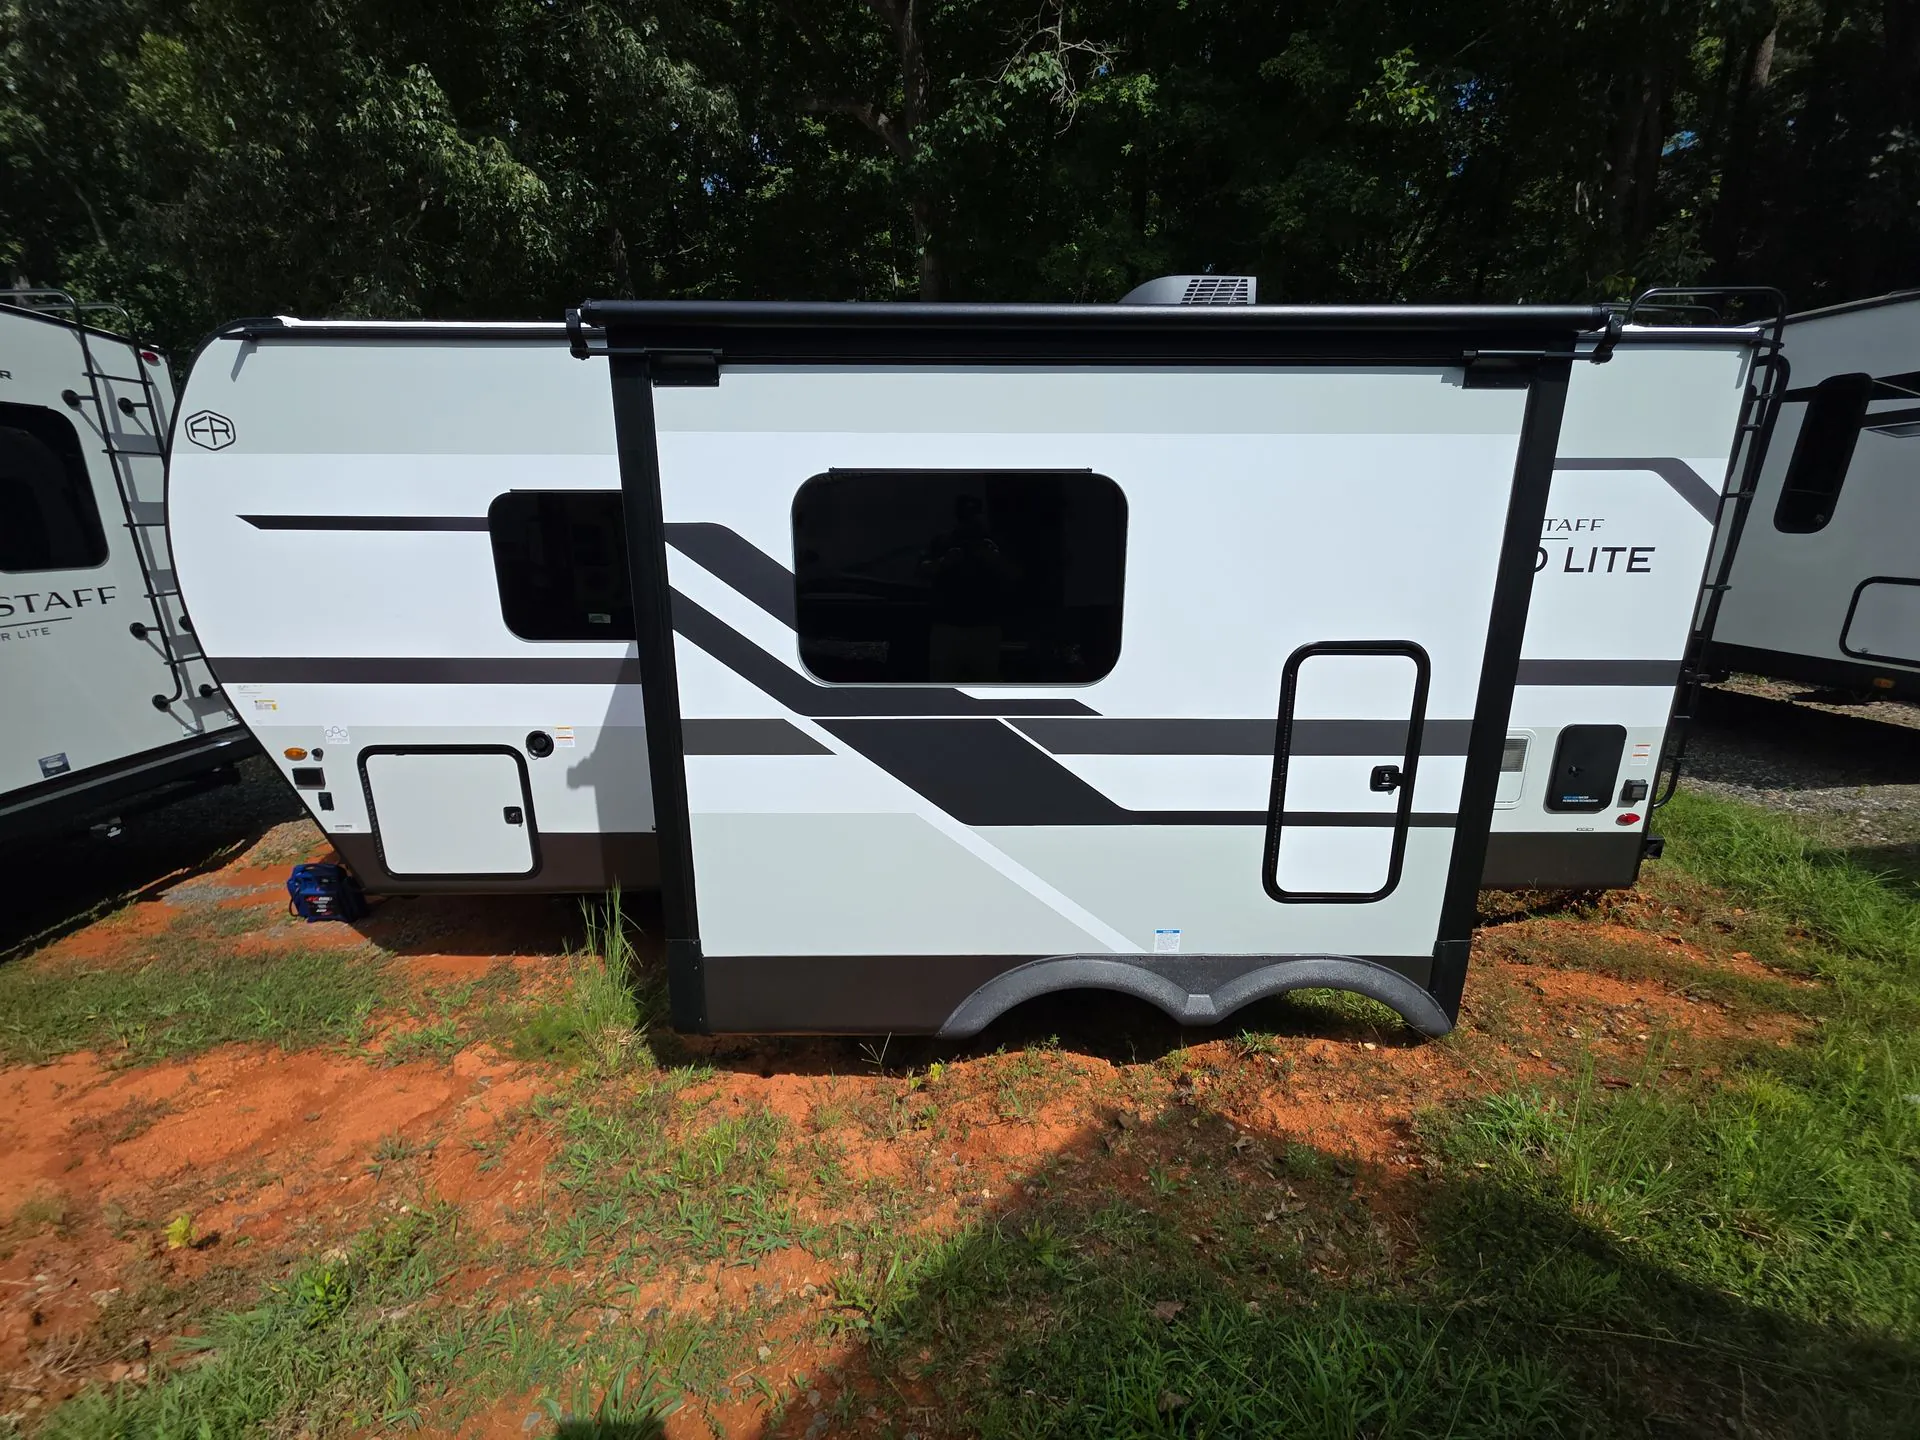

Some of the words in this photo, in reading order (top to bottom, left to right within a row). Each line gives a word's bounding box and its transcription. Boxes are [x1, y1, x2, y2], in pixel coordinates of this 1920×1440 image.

[1563, 546, 1656, 573] LITE
[0, 585, 117, 618] STAFF
[17, 626, 51, 640] LITE
